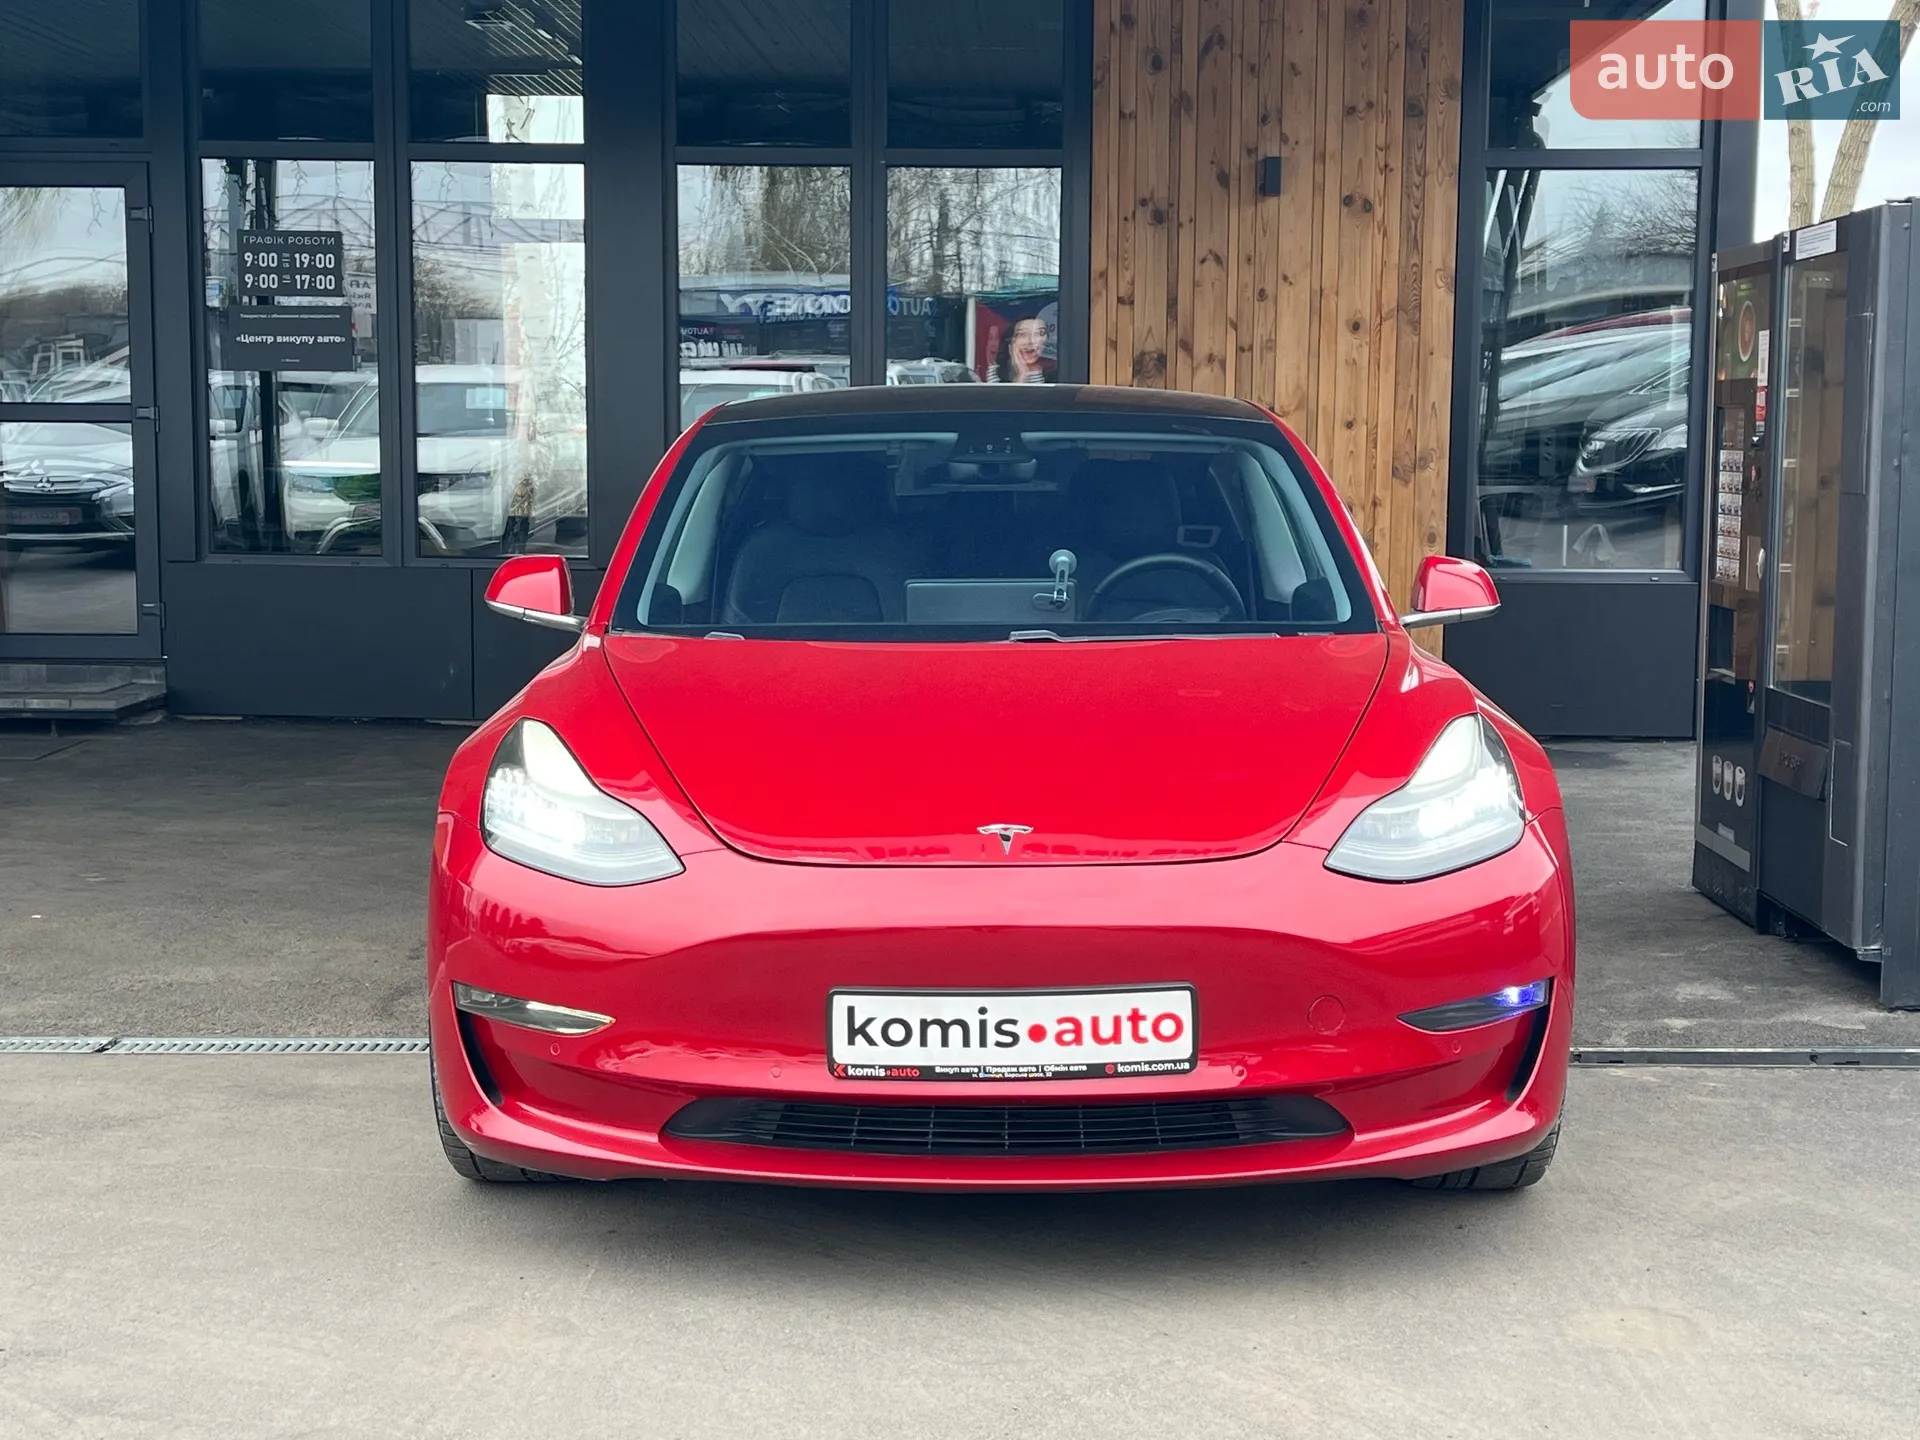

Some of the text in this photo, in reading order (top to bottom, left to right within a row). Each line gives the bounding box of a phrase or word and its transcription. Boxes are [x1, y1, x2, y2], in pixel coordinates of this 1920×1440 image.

[243, 236, 335, 246] ГРАФІК РОБОТИ
[244, 252, 335, 269] 9:00 19:00
[244, 274, 335, 290] 9:00 17:00
[236, 334, 346, 344] «Центр викупу авто»
[935, 1066, 960, 1074] Викуп
[986, 1065, 1018, 1073] Продаж
[1043, 1064, 1069, 1072] Обмін
[1117, 1062, 1190, 1072] komis.com.ua
